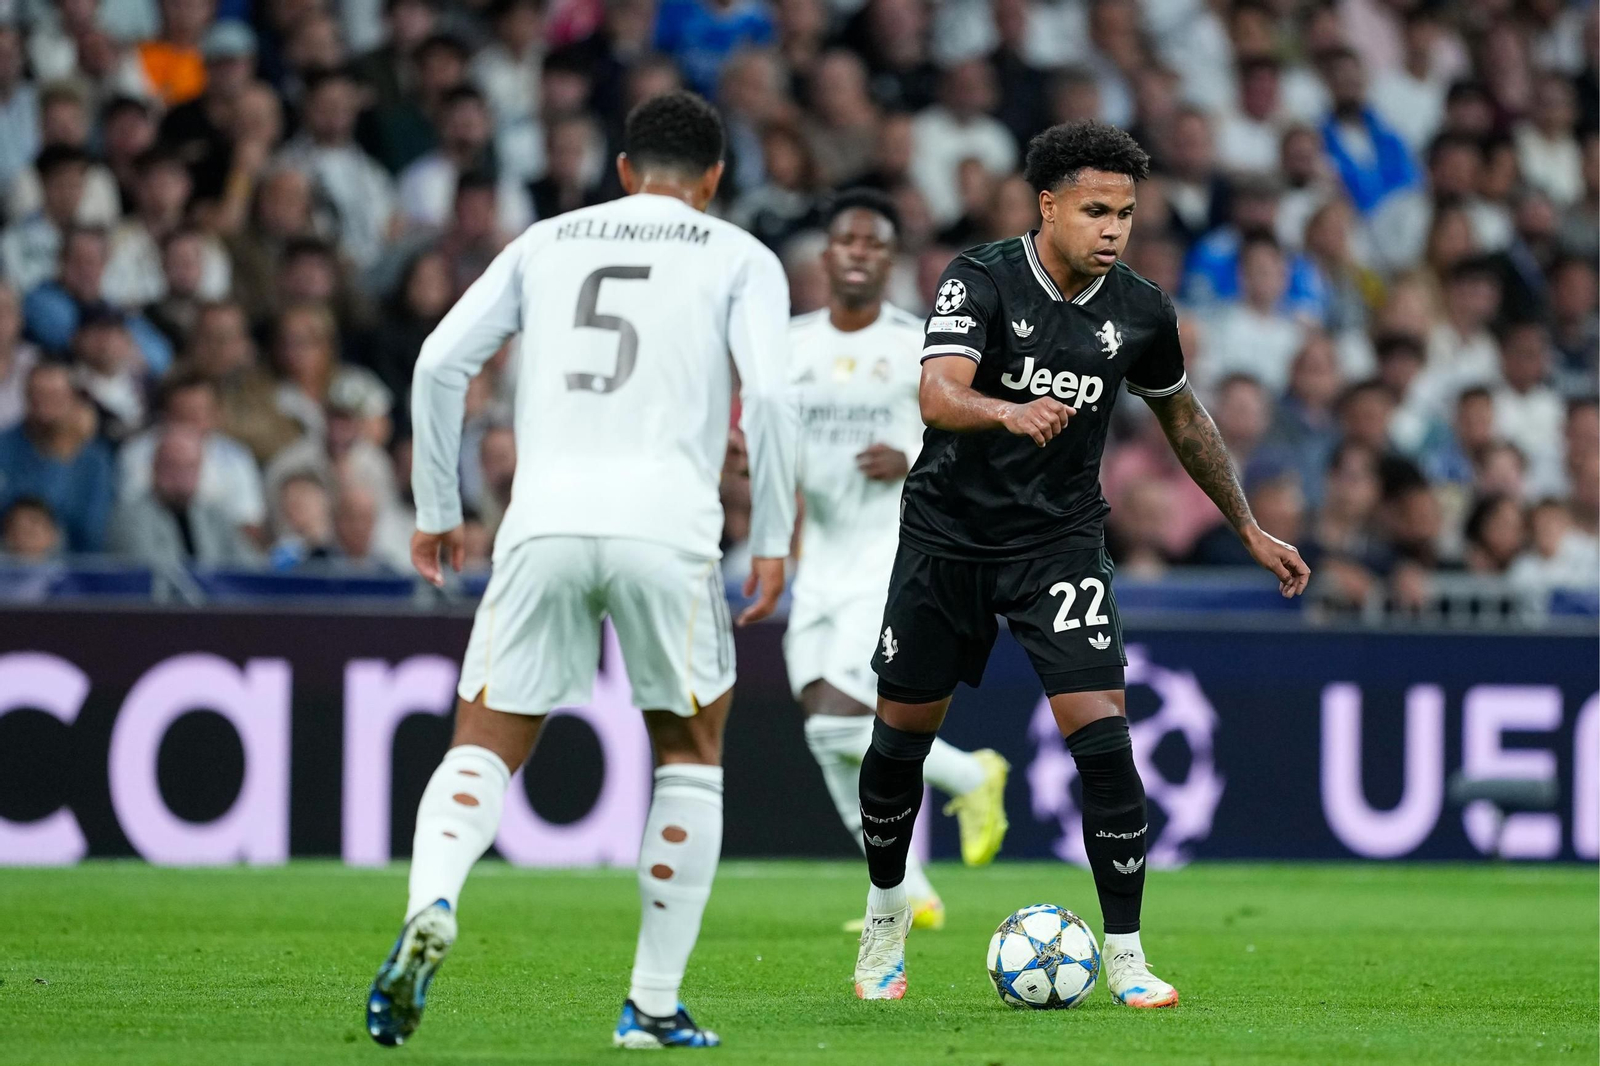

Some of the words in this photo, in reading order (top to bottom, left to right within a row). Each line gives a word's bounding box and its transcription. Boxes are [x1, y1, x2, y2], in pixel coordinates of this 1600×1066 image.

[556, 219, 711, 246] BELLINGHAM
[564, 265, 652, 393] 5
[1001, 356, 1104, 409] Jeep
[1048, 577, 1109, 633] 22
